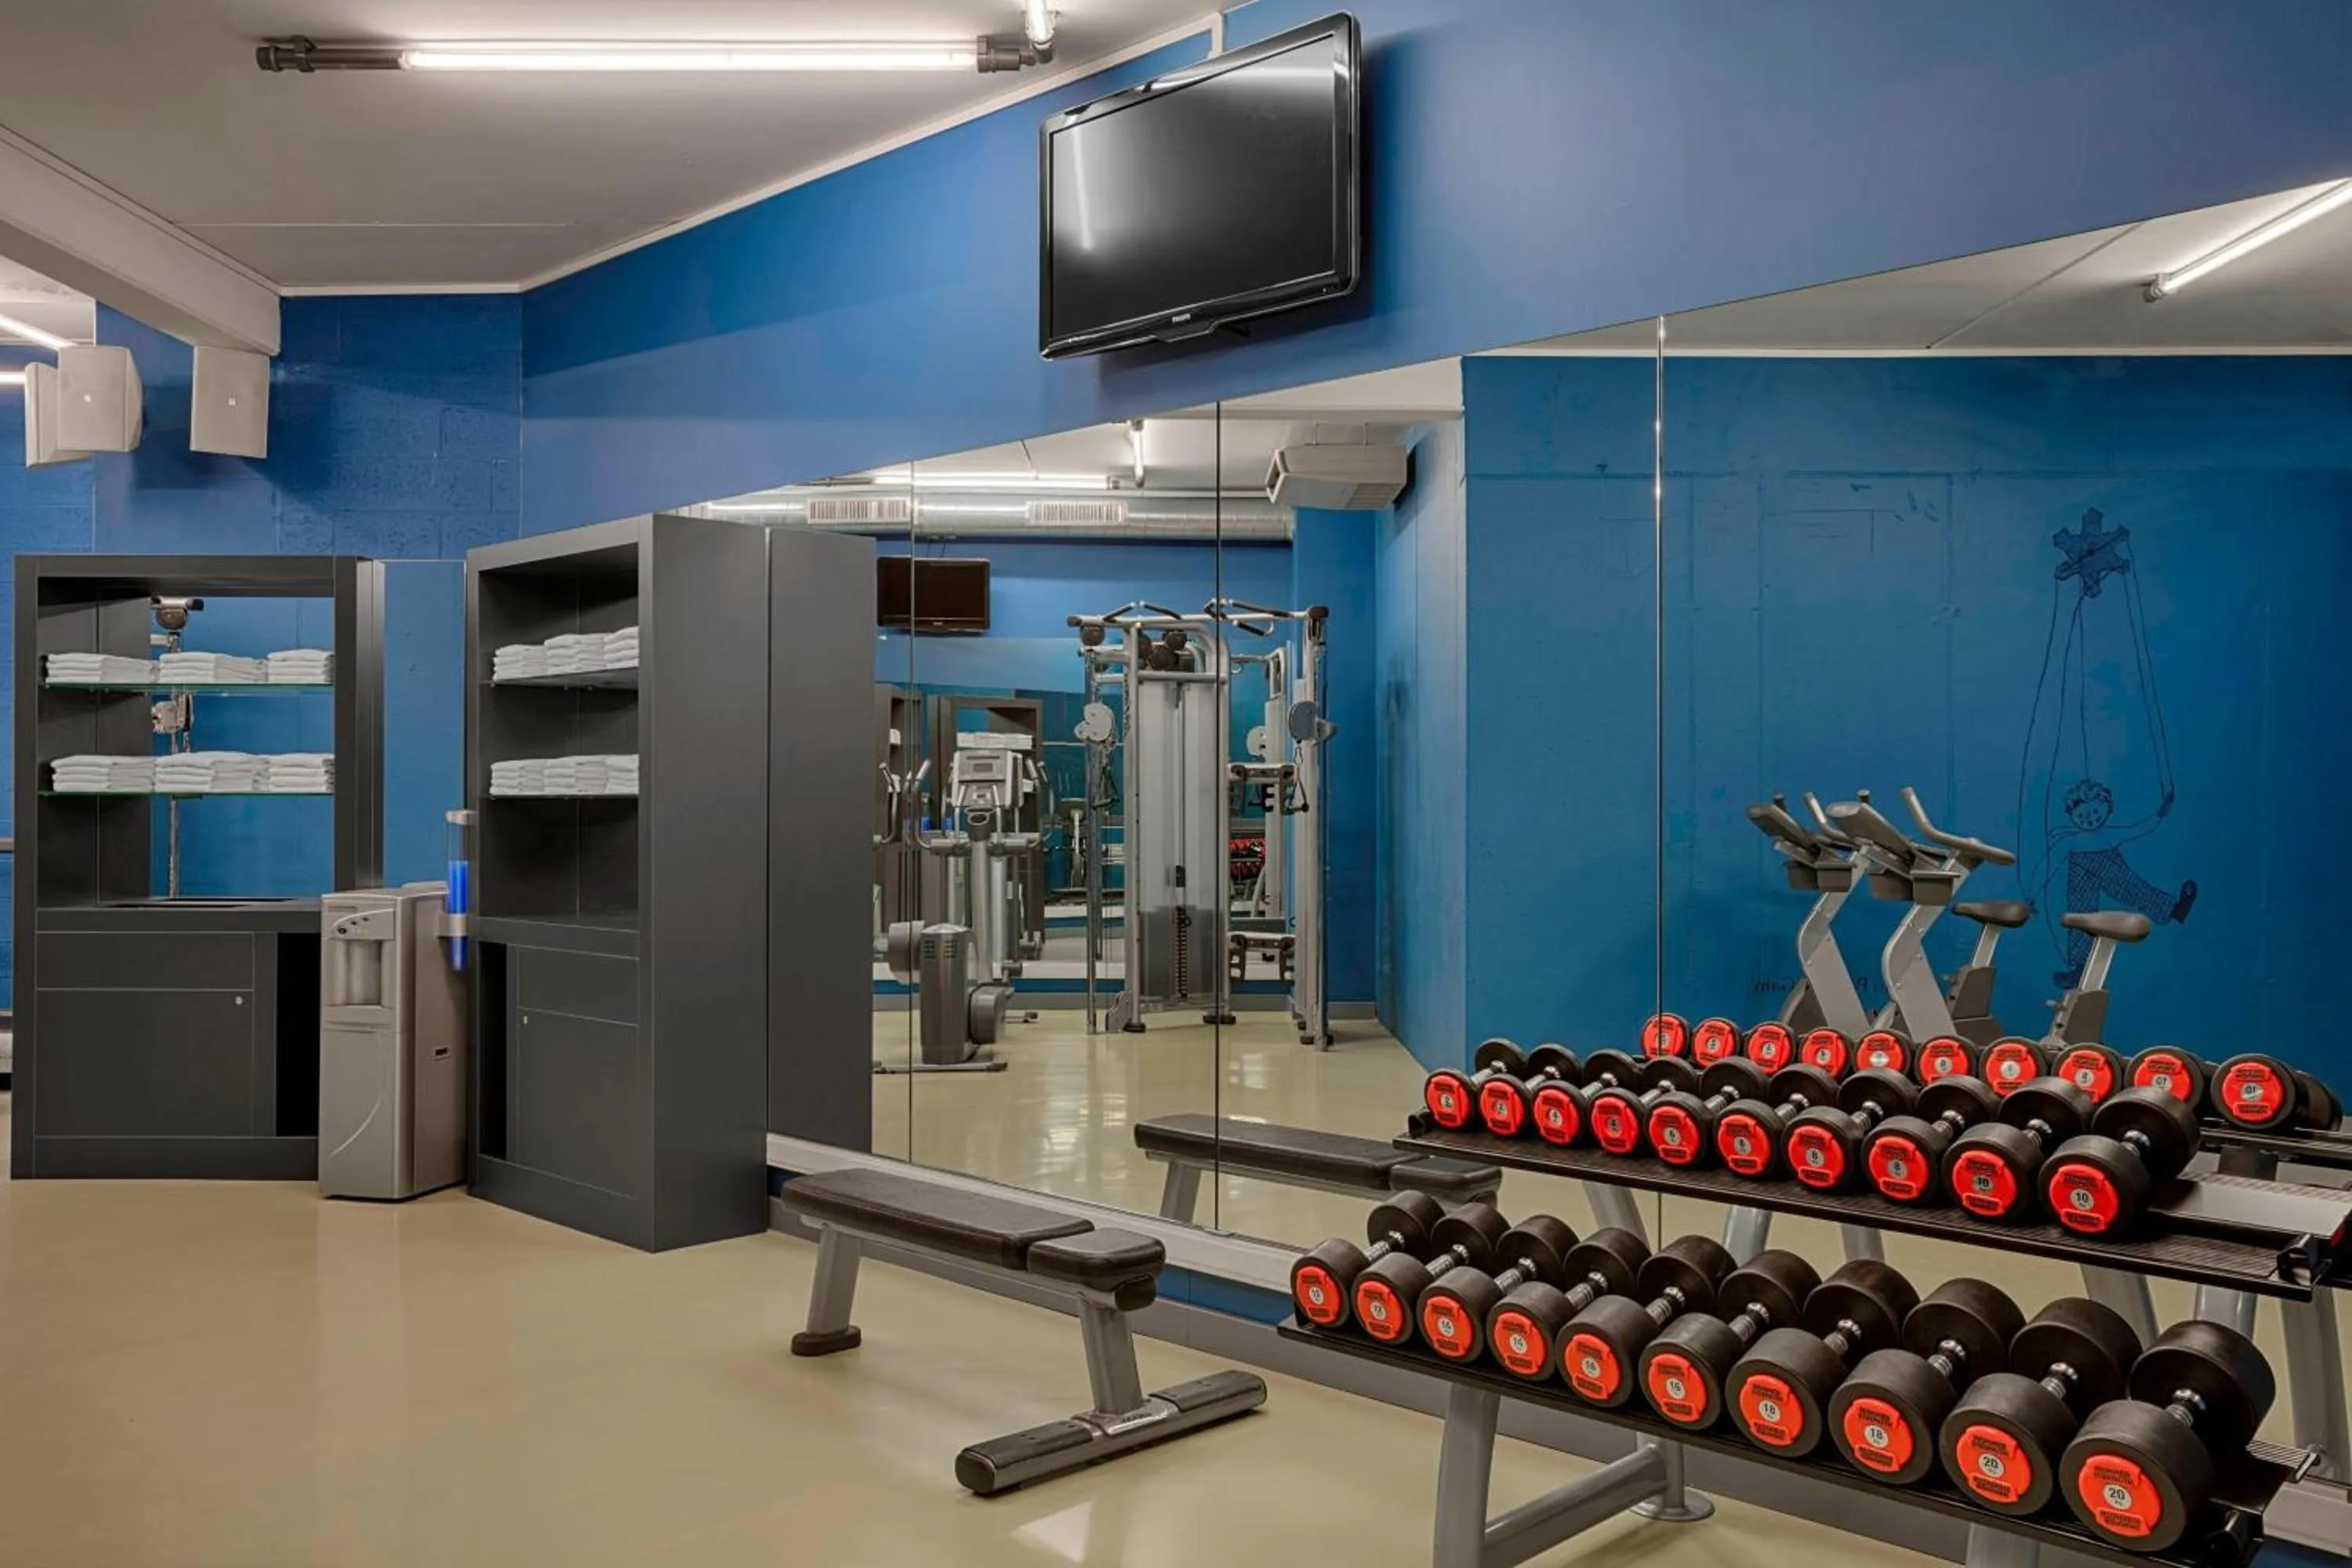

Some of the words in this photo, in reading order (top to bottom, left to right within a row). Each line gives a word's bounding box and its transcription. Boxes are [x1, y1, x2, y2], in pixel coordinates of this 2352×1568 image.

[1976, 1177, 1989, 1188] 10
[2075, 1192, 2089, 1203] 10
[1984, 1457, 1998, 1468] 20
[2108, 1487, 2125, 1500] 20
